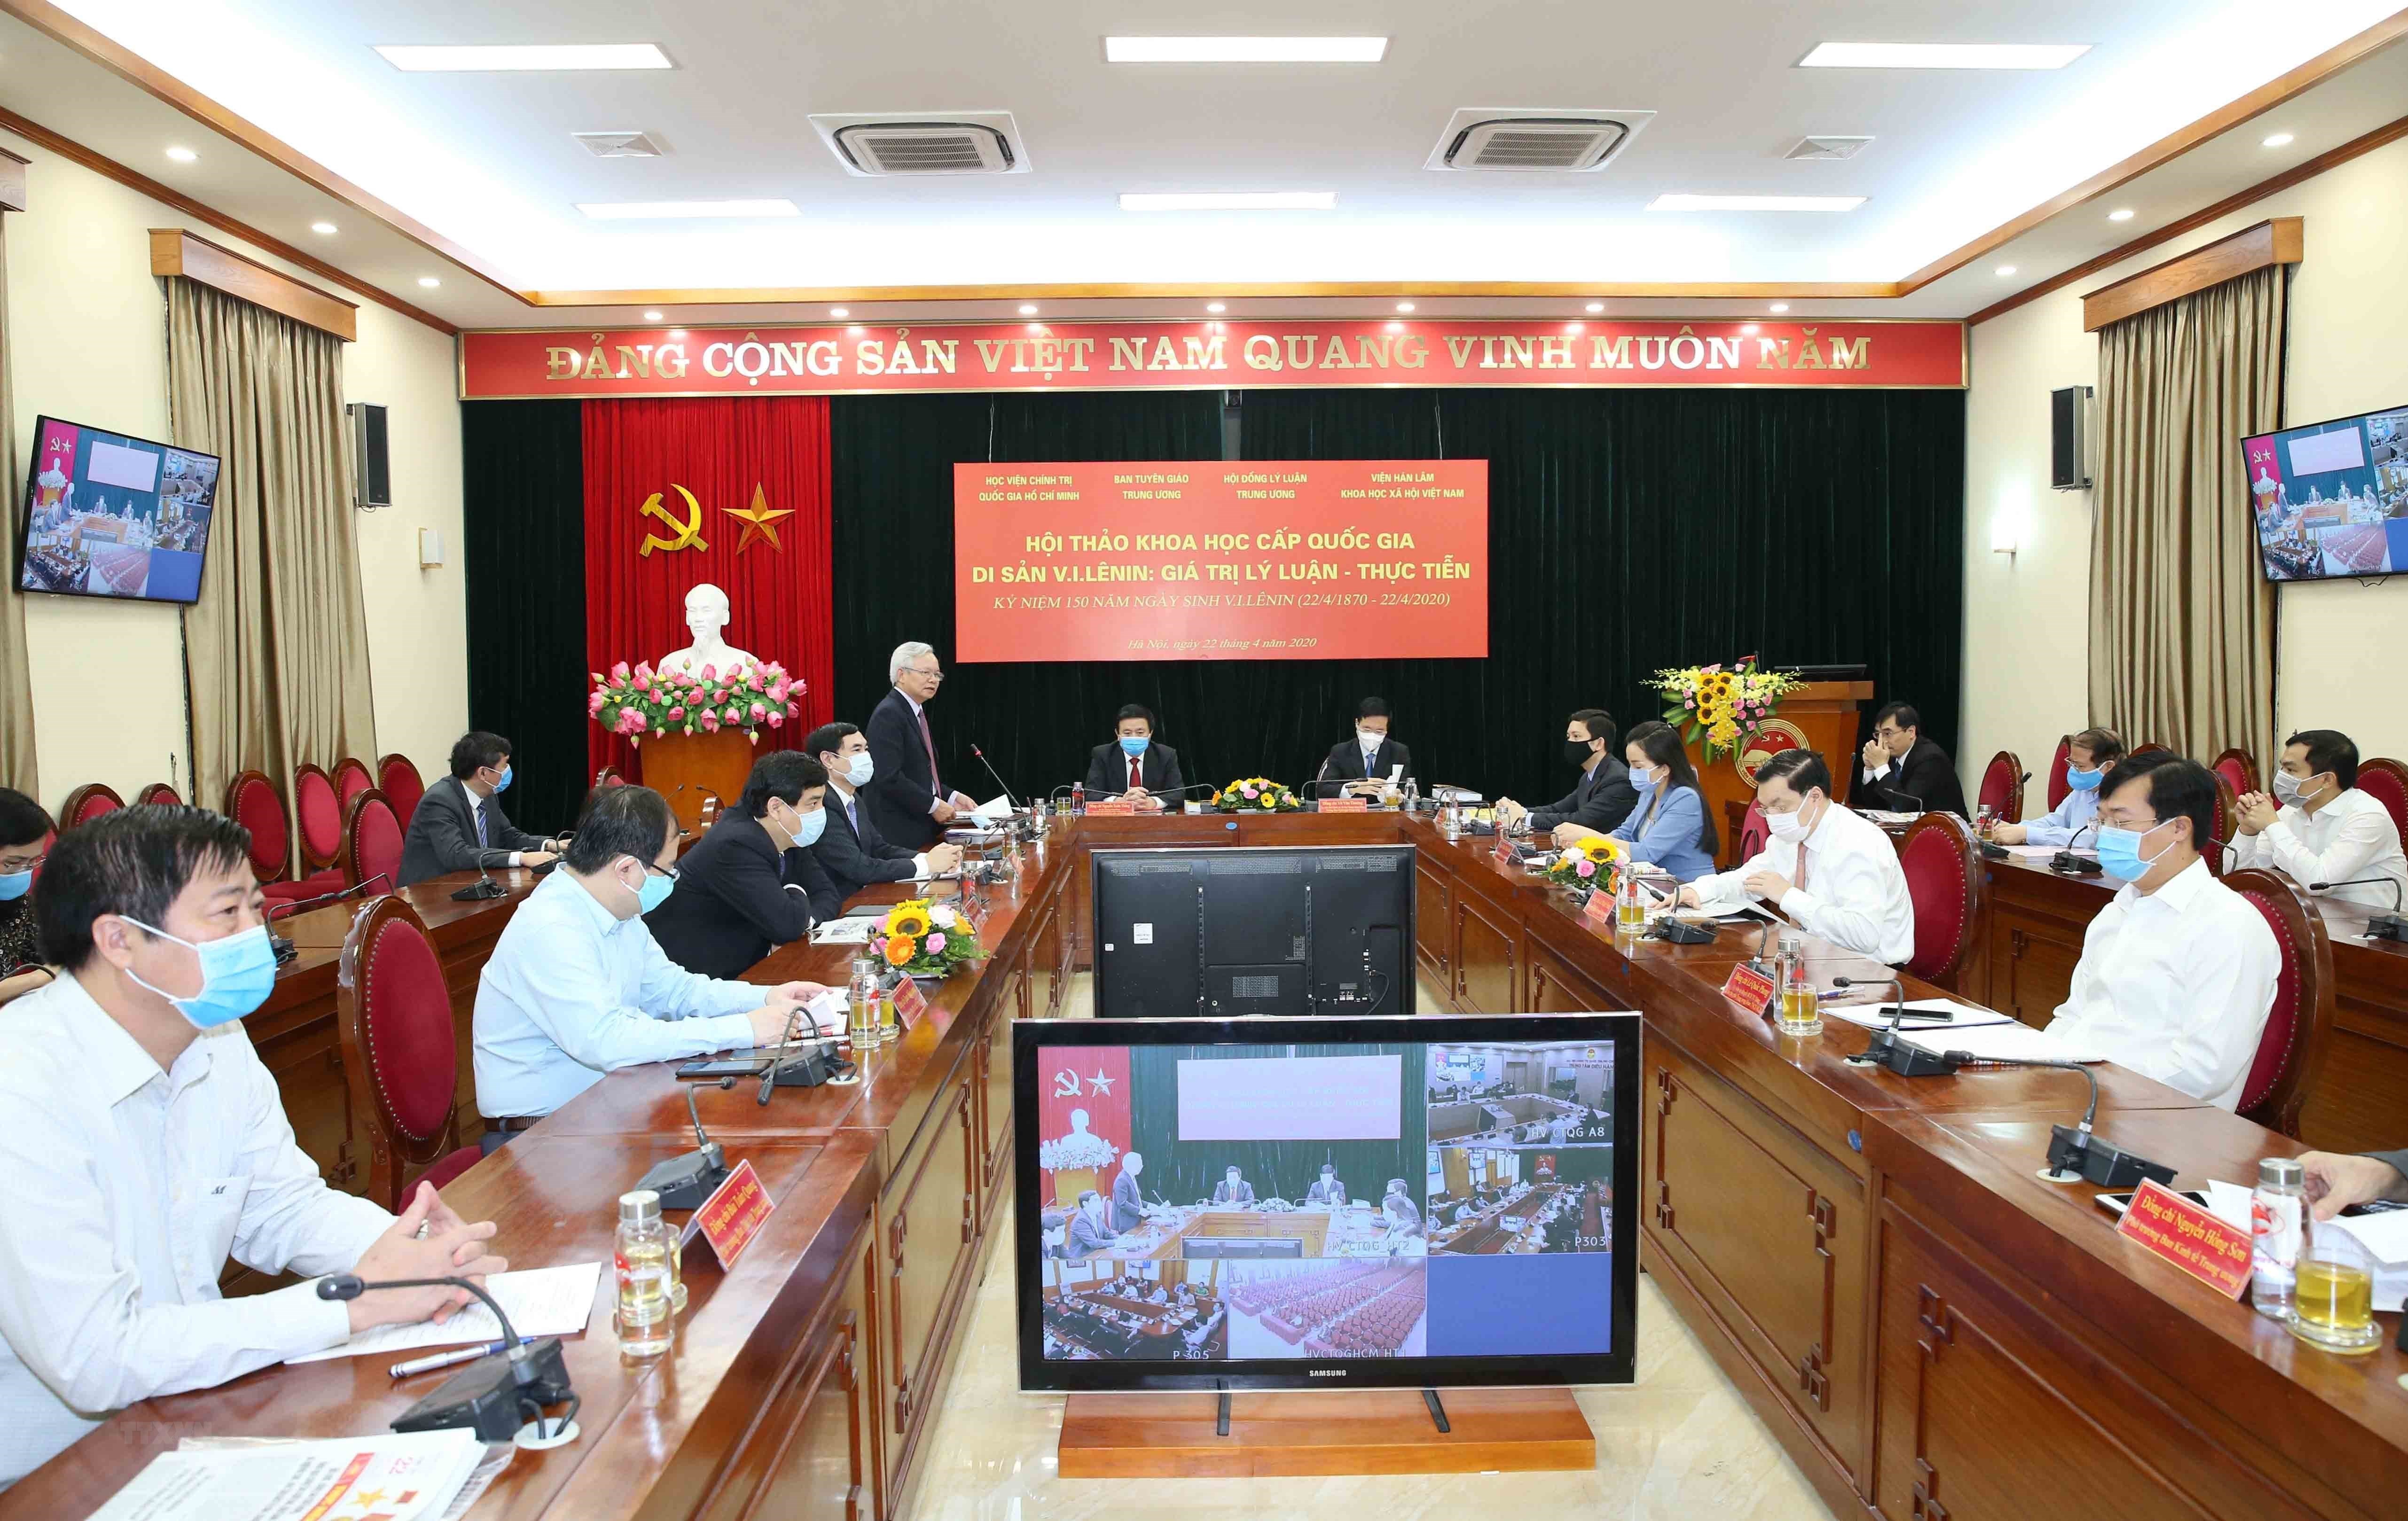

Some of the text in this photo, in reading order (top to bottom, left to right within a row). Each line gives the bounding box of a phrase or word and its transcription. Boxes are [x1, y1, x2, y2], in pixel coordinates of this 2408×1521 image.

[547, 323, 1872, 386] ĐẢNG CỘNG SẢN VIỆT NAM QUANG VINH MUÔN NĂM
[985, 474, 1072, 488] HỌC VIỆN CHÍNH TRỊ
[1114, 472, 1189, 484] BAN TUYÊN GIÁO
[1223, 472, 1239, 484] HỘI
[1269, 472, 1281, 483] LÝ
[1282, 471, 1307, 483] LUẬN
[1371, 471, 1392, 484] VIỆN
[1415, 471, 1434, 482] LÂM
[979, 489, 1004, 501] QUỐC
[1006, 492, 1023, 501] GIA
[1039, 490, 1055, 501] CHÍ
[1056, 491, 1079, 500] MINH
[1122, 490, 1181, 499] TRUNG ƯƠNG
[1236, 489, 1296, 499] TRUNG ƯƠNG
[1341, 487, 1464, 500] KHOA HỌC XÃ HỘI VIỆT NAM
[1026, 526, 1415, 557] HỘI THẢO KHOA HỌC CẤP QUỐC GIA
[972, 567, 994, 583] DI
[1001, 560, 1046, 583] SẢN
[1052, 561, 1154, 582] V.I.LÊNIN:
[1161, 560, 1200, 581] GIÁ
[1205, 564, 1238, 585] TRỊ
[1246, 560, 1272, 580] LÝ
[1279, 559, 1338, 585] LUẬN
[1357, 561, 1416, 585] THỰC
[1422, 554, 1470, 579] TIỄN
[993, 594, 1017, 609] KỶ
[1021, 595, 1061, 610] NIỆM
[1067, 596, 1089, 608] 150
[1093, 593, 1130, 608] NĂM
[1133, 593, 1179, 607] NGÀY
[1183, 595, 1221, 607] SINH
[1225, 591, 1294, 606] V.I.LÊNIN
[1298, 593, 1368, 608] (22/4/1870
[1380, 593, 1450, 607] 22/4/2020)
[1203, 639, 1217, 648] 22
[1219, 639, 1250, 650] tháng
[1252, 639, 1260, 647] 4
[1262, 639, 1286, 647] năm
[1288, 638, 1317, 647] 2020
[1532, 1128, 1547, 1138] HV
[1588, 1127, 1605, 1137] A8
[1575, 1236, 1606, 1247] P303
